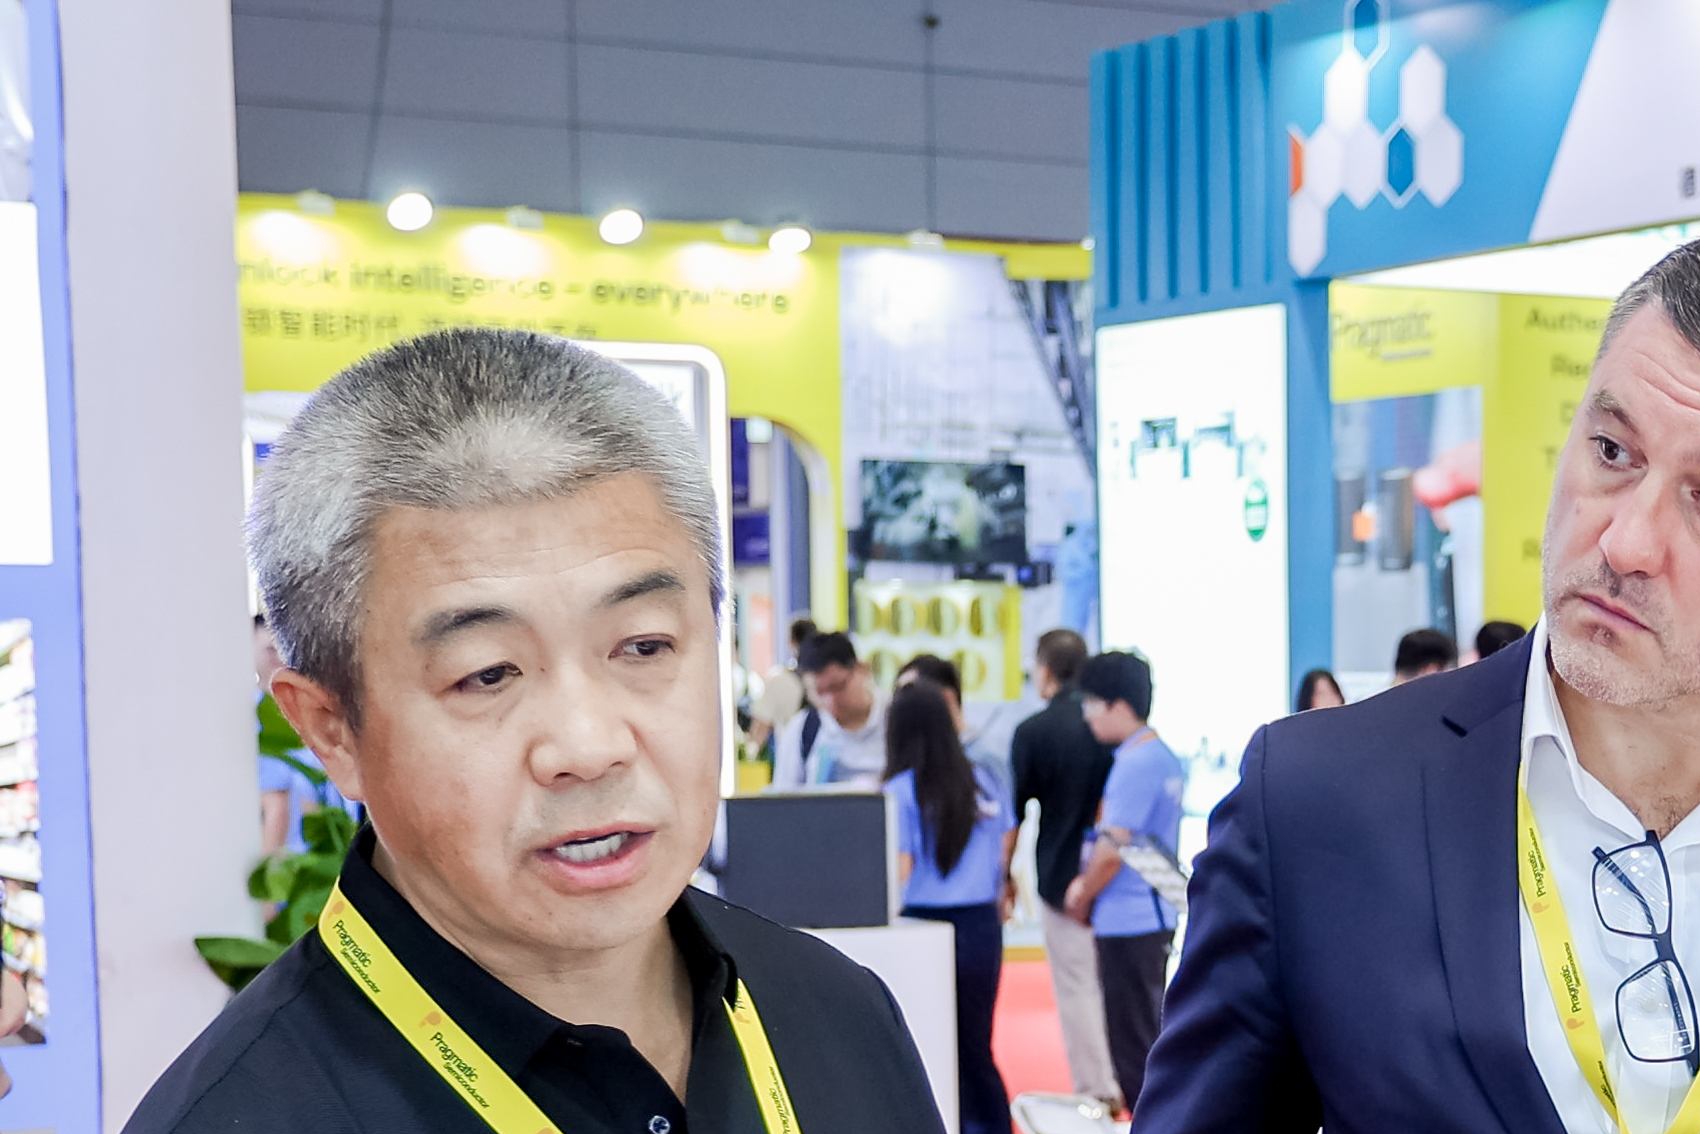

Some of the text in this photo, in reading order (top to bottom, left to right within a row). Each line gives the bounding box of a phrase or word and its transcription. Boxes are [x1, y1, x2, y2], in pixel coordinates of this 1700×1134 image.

[333, 919, 372, 972] Pragmatic
[430, 1031, 480, 1084] Pragmatic
[443, 1062, 490, 1109] Semiconductor
